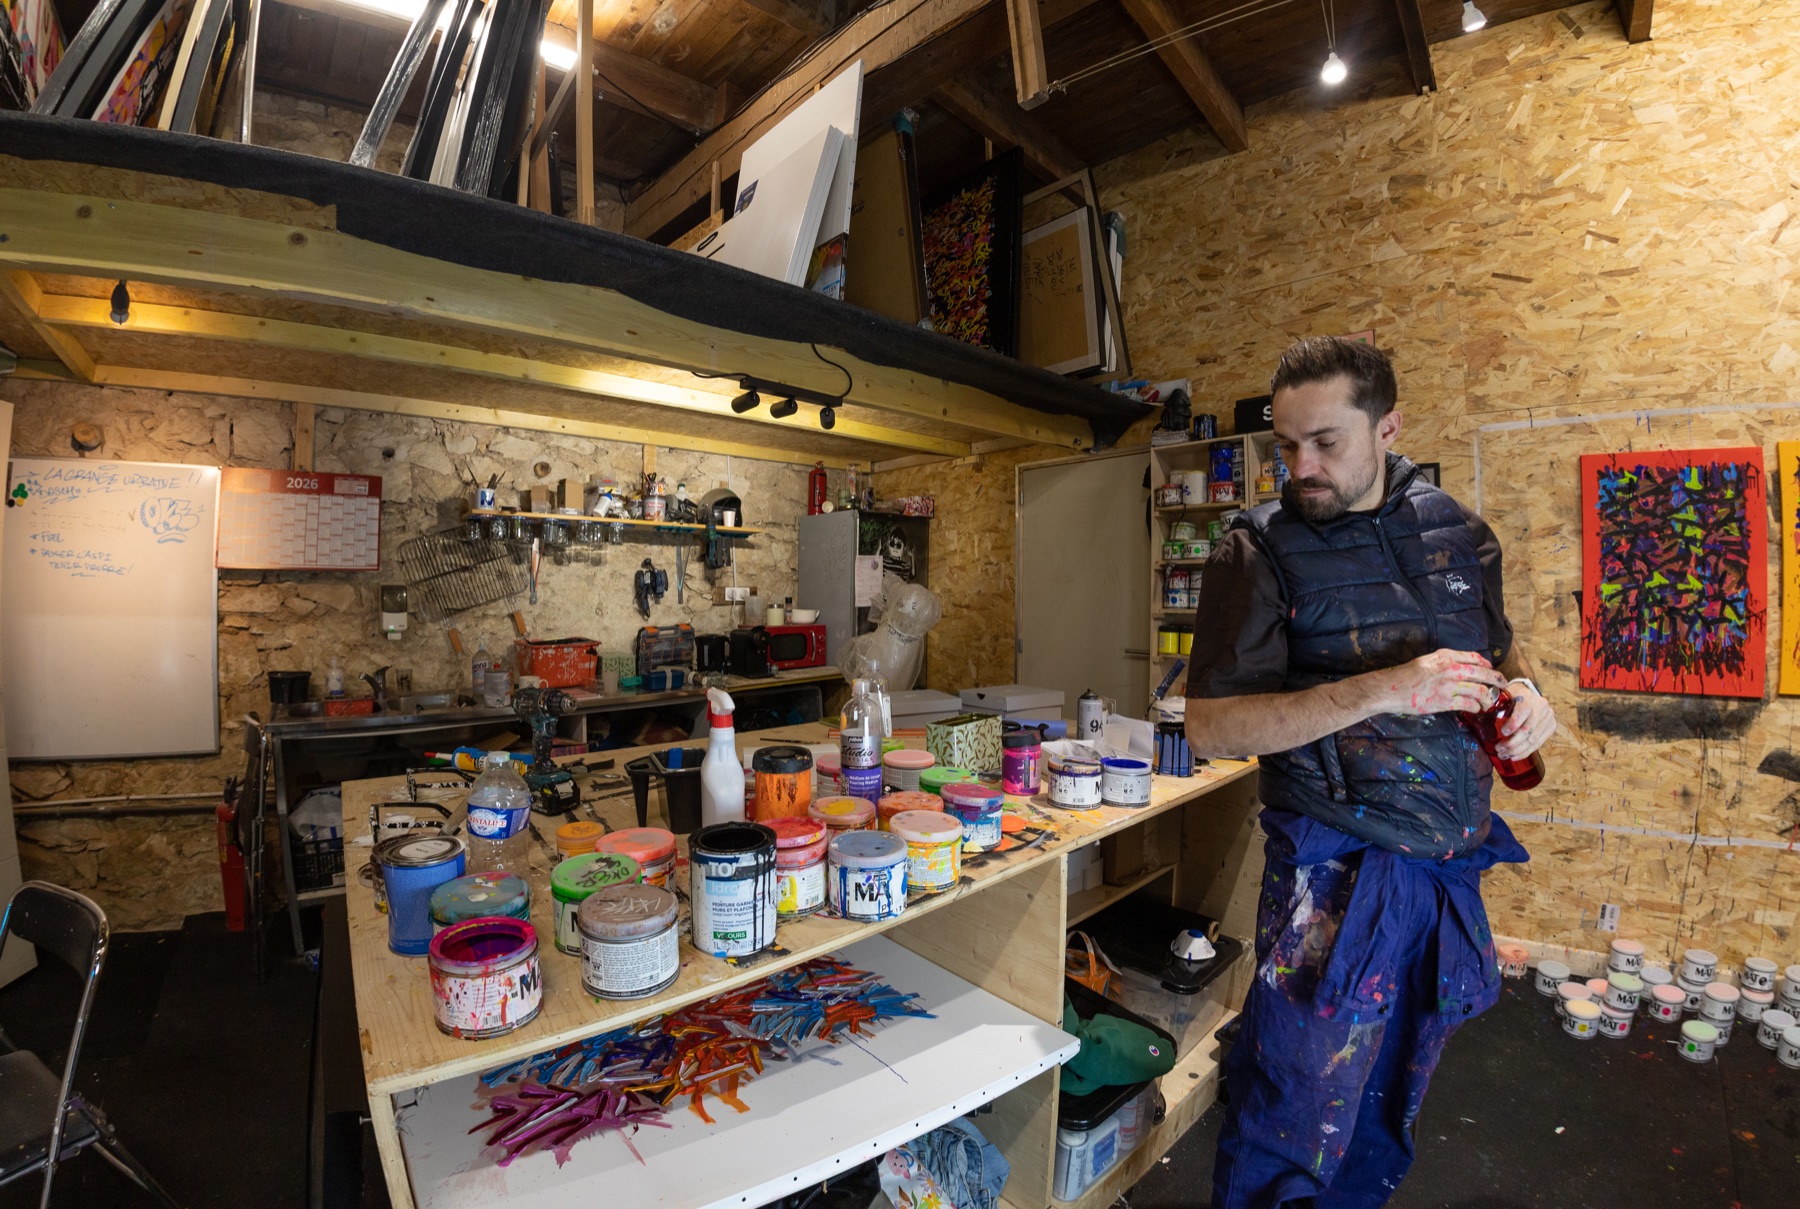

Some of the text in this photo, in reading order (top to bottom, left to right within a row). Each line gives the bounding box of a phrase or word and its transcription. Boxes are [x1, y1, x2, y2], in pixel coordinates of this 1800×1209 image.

[286, 477, 319, 490] 2026
[468, 815, 506, 827] RISTALINE
[1695, 967, 1713, 977] MAT
[1617, 993, 1638, 1004] MAT
